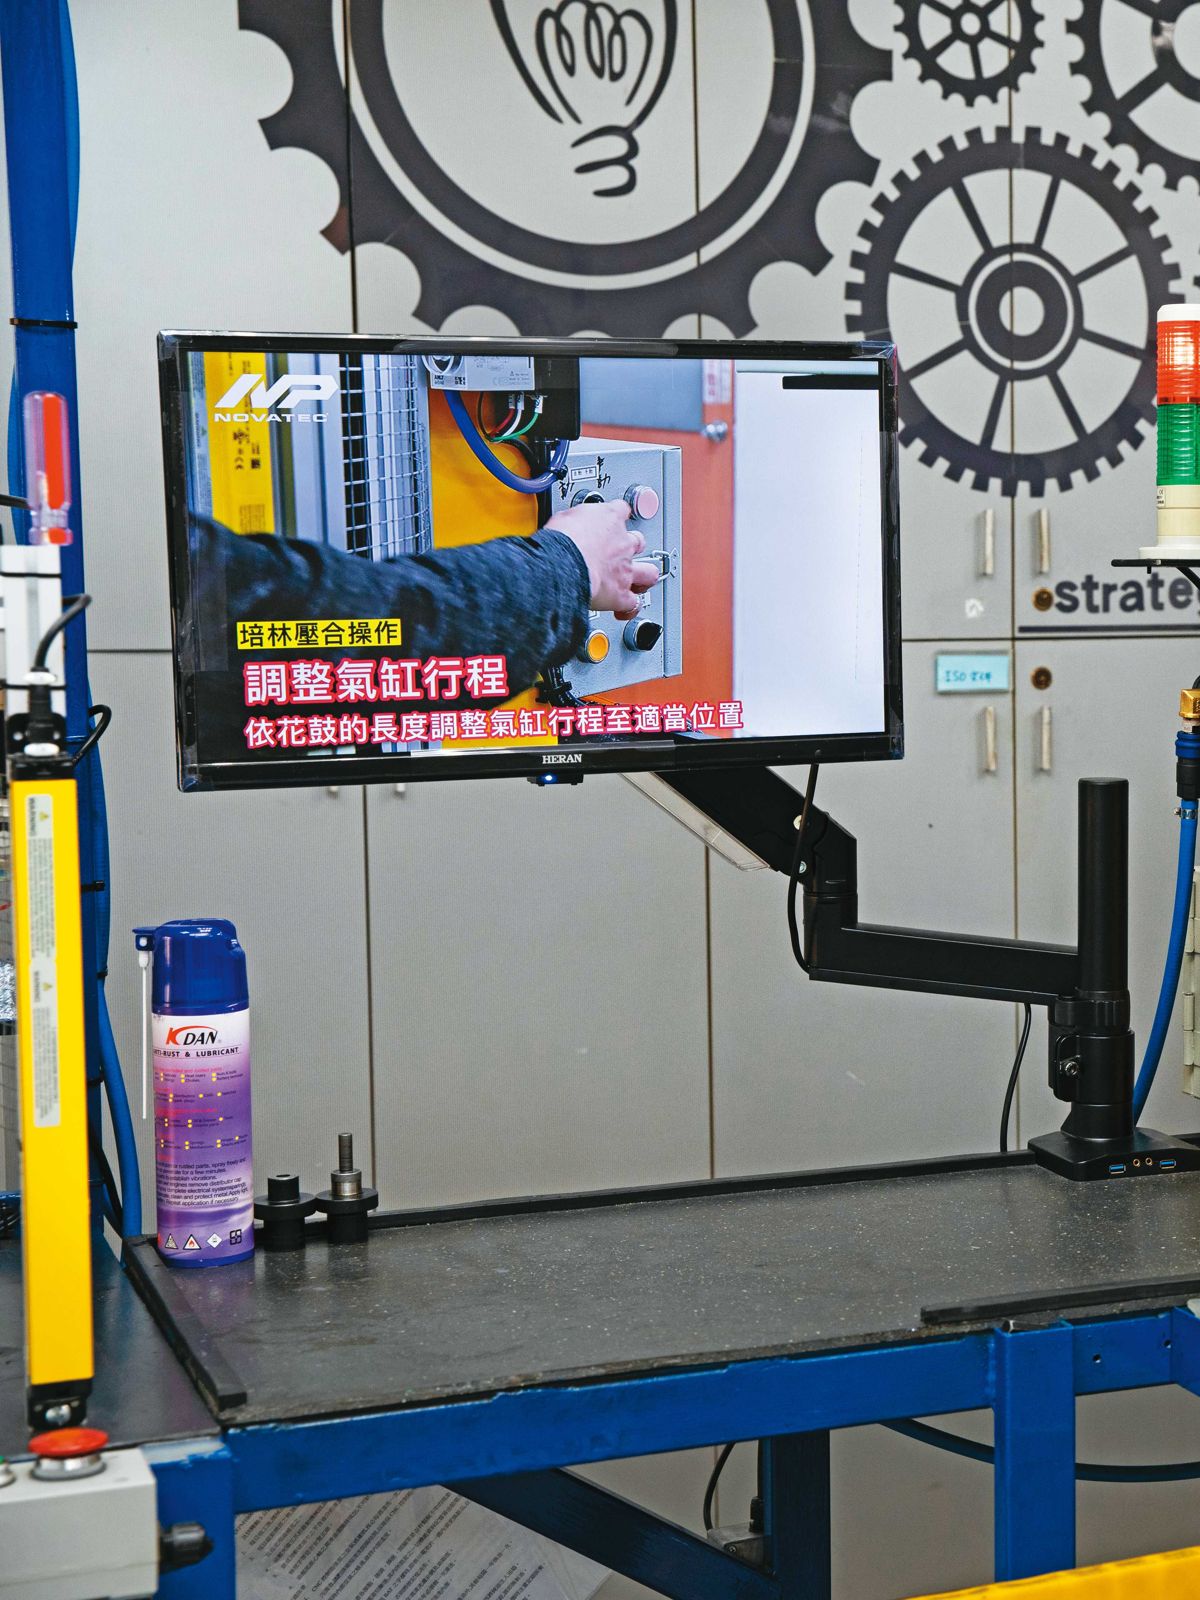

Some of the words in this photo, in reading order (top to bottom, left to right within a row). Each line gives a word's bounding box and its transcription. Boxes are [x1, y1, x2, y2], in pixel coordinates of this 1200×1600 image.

[214, 412, 328, 423] NOVATEC
[239, 619, 399, 648] 培林壓合操作
[244, 657, 508, 705] 調整氣缸行程
[243, 699, 744, 748] 依花鼓的長度調整氣缸行程至適當位置
[542, 753, 582, 764] HERAN
[196, 1046, 239, 1057] LUBRICANT
